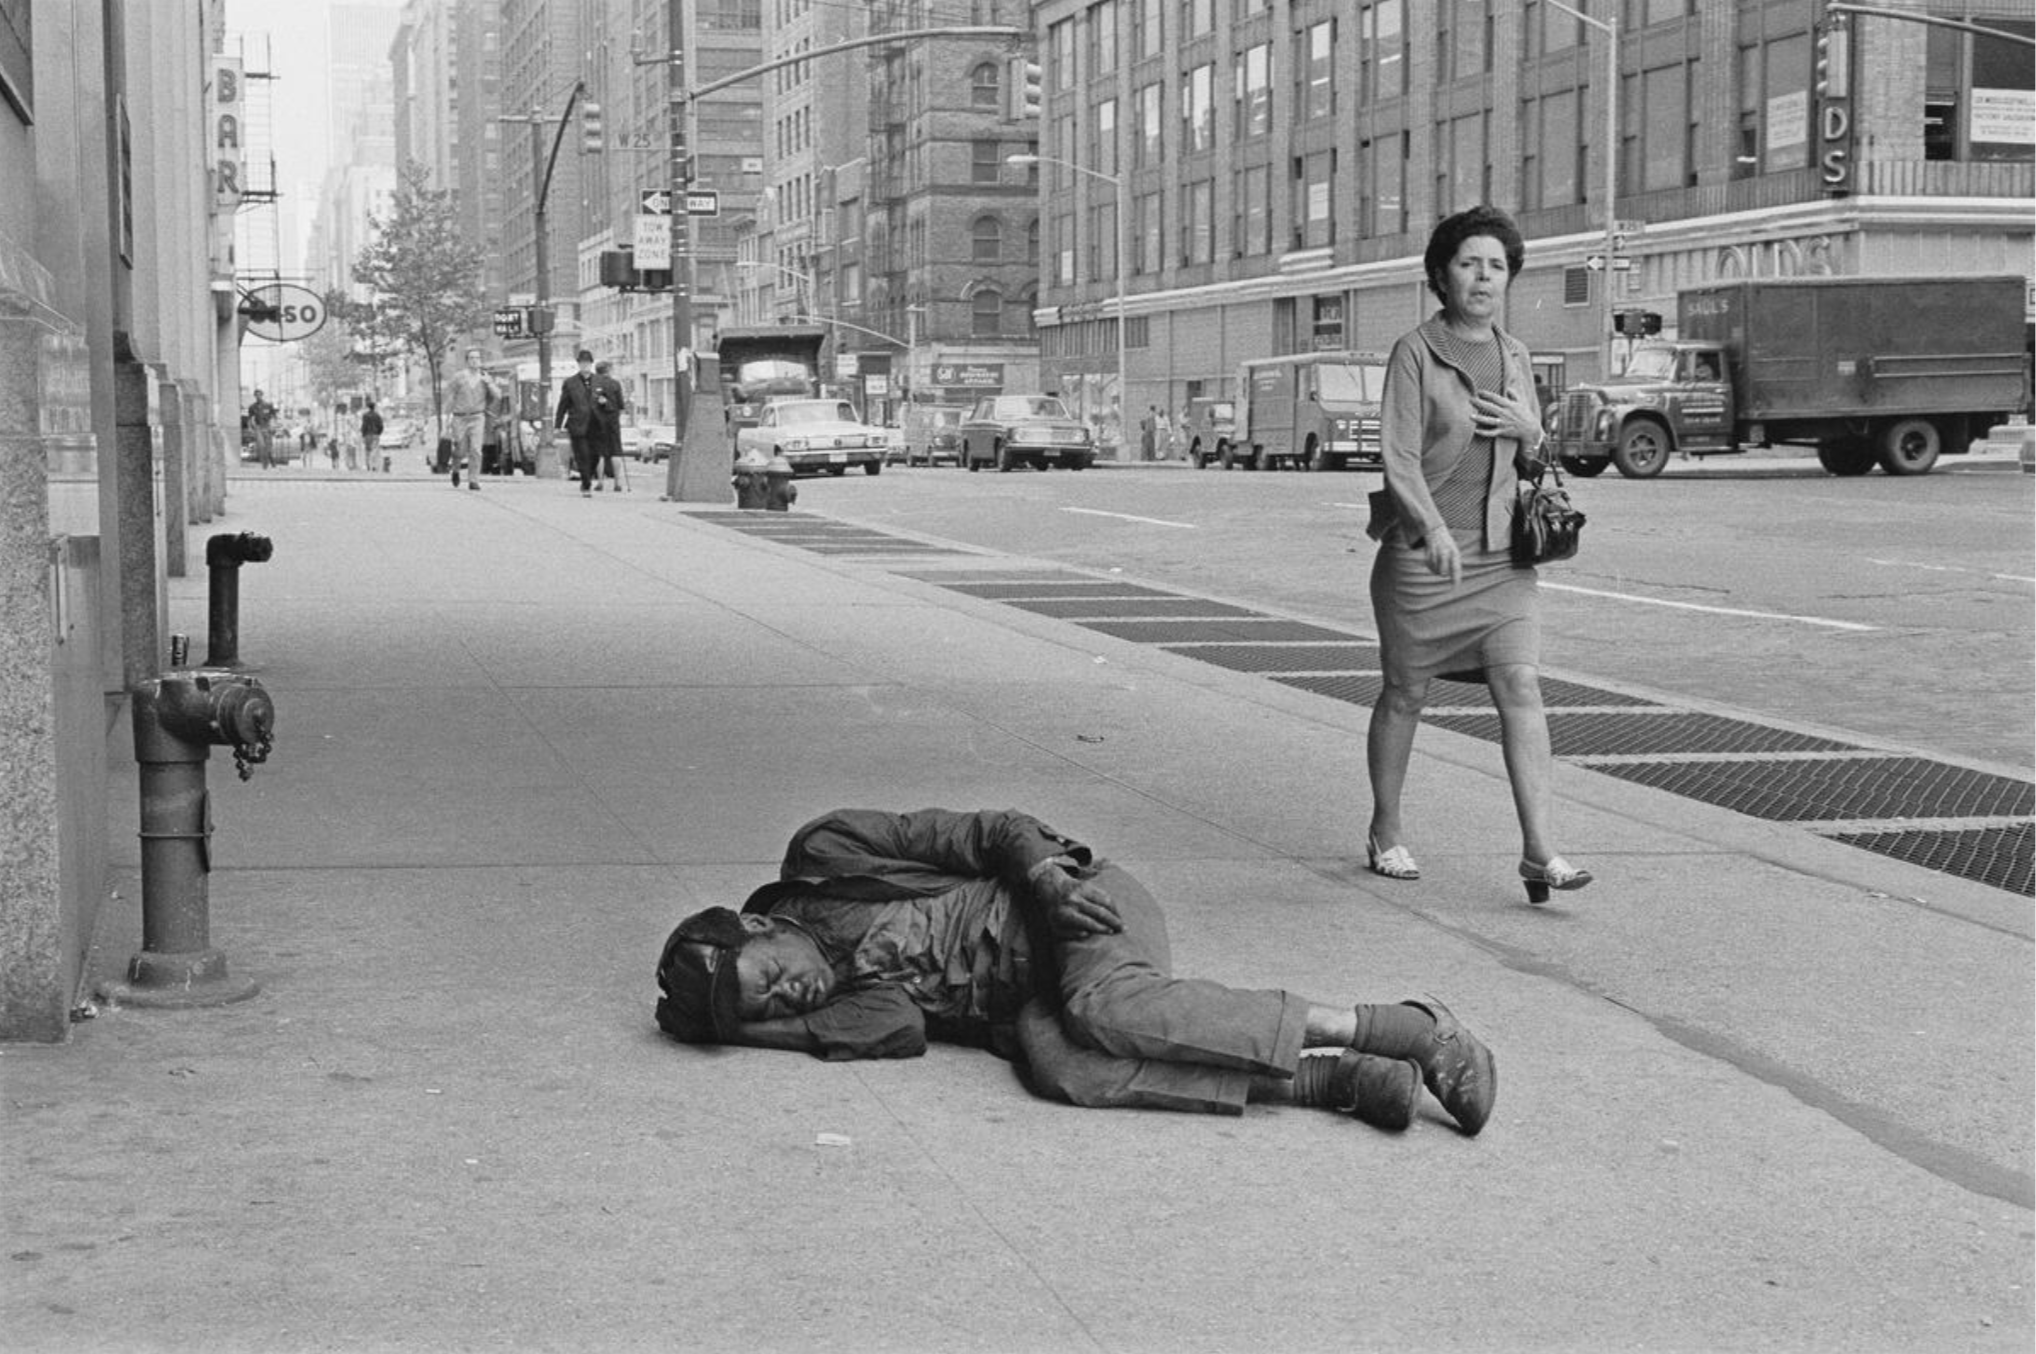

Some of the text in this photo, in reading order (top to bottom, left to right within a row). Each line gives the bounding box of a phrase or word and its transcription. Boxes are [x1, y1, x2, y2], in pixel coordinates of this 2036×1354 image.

[217, 68, 239, 194] BAR
[618, 133, 651, 148] W 25
[689, 199, 713, 208] WAY
[643, 222, 663, 231] TOW
[639, 235, 667, 244] AWAY
[638, 249, 667, 259] ZONE
